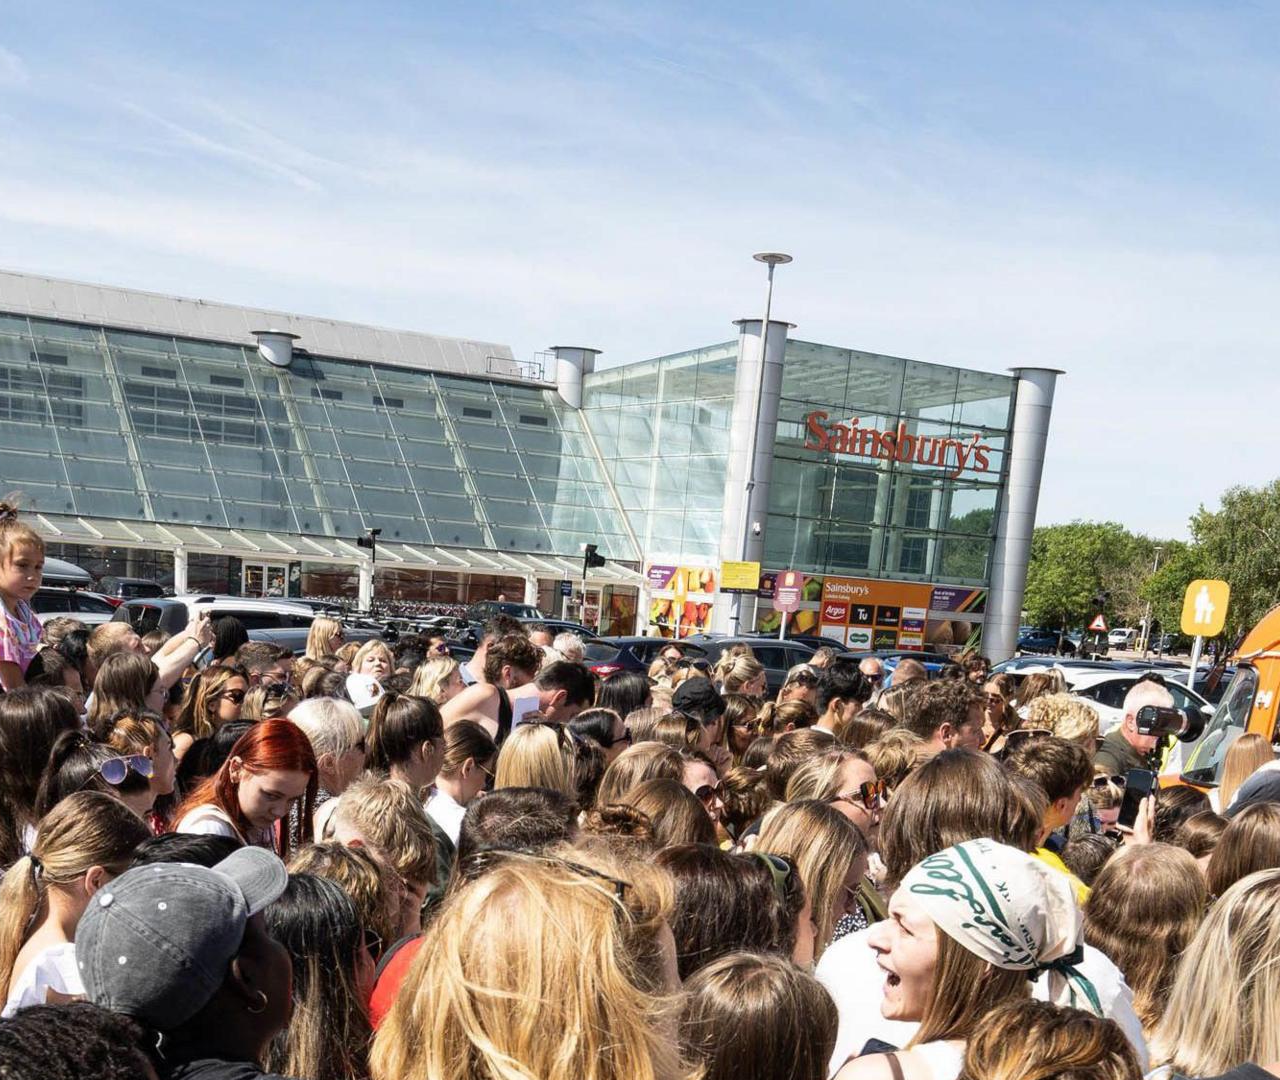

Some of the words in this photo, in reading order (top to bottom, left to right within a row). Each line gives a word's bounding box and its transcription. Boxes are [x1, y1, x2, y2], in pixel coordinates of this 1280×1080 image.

[804, 410, 992, 480] Sainsbury's
[825, 582, 870, 596] Sainsbury's
[825, 604, 846, 616] Argos
[857, 608, 868, 621] Tu
